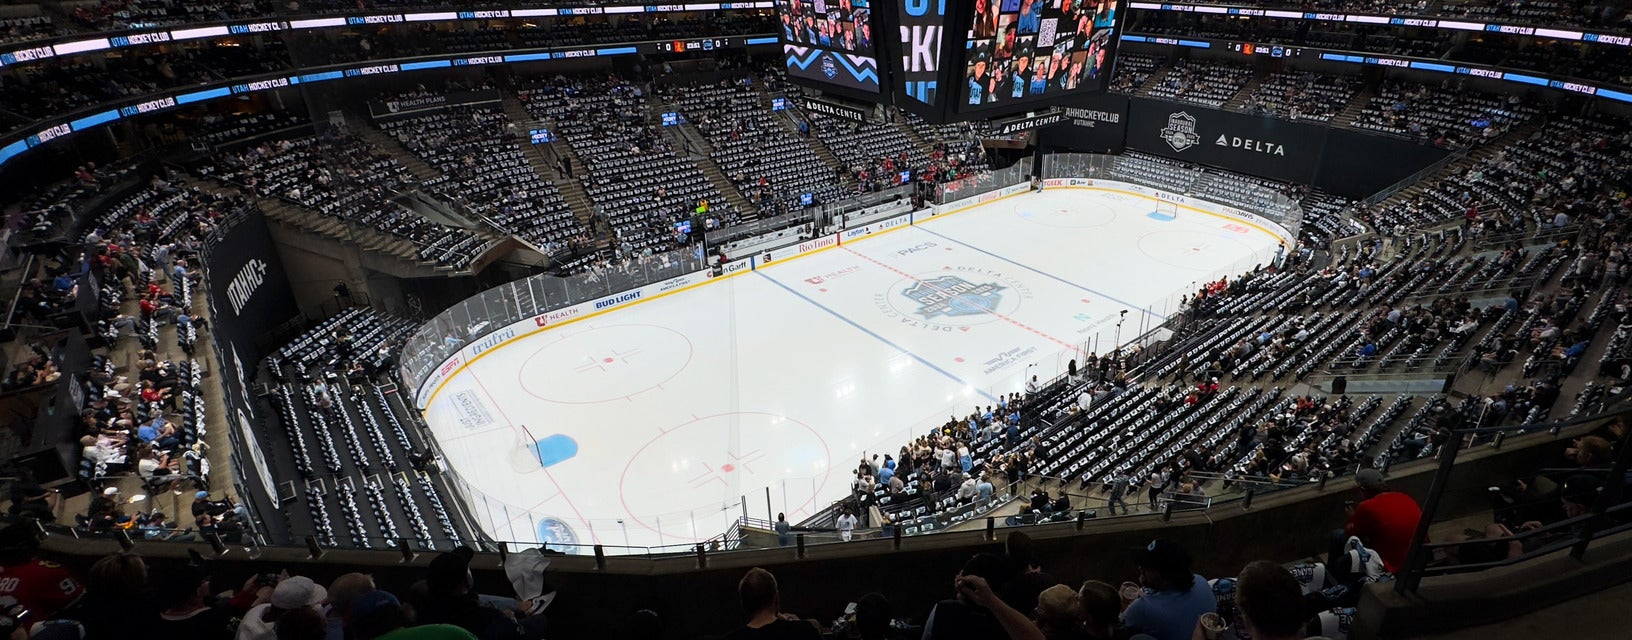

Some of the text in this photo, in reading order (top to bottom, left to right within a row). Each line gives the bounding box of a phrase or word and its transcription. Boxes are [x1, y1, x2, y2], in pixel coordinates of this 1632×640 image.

[347, 14, 403, 25] UTAH HOCKEY CLUB
[474, 10, 495, 18] HOCKEY
[230, 25, 248, 34] UTAH
[249, 22, 272, 32] HOCKEY
[1404, 18, 1423, 26] HOCKEY
[1486, 24, 1534, 35] UTAH HOCKEY CLUB
[128, 33, 152, 45] HOCKEY
[1583, 33, 1631, 46] UTAH HOCKEY CLUB
[564, 50, 583, 58] HOCKEY
[467, 56, 488, 65] HOCKEY
[1378, 58, 1396, 66] HOCKEY
[345, 64, 399, 77] UTAH HOCKEY CLUB
[1469, 68, 1489, 77] HOCKEY
[232, 78, 288, 94] UTAH HOCKEY CLUB
[1563, 82, 1582, 92] HOCKEY
[1582, 85, 1596, 95] CLUB
[121, 97, 175, 117] UTAH HOCKEY CLUB
[400, 99, 425, 108] HEALTH
[426, 95, 446, 104] PLANS
[813, 104, 863, 121] DELTA CENTER
[1011, 115, 1060, 132] DELTA CENTER
[1169, 123, 1193, 134] SEASON
[1232, 137, 1285, 156] DELTA
[1161, 193, 1185, 203] DELTA
[886, 217, 908, 227] DELTA
[897, 241, 938, 257] PACS
[729, 261, 747, 272] Garff
[227, 259, 267, 316] UTAHHC+
[918, 282, 977, 305] SEASON
[595, 291, 642, 309] BUD LIGHT
[550, 307, 579, 320] HEALTH
